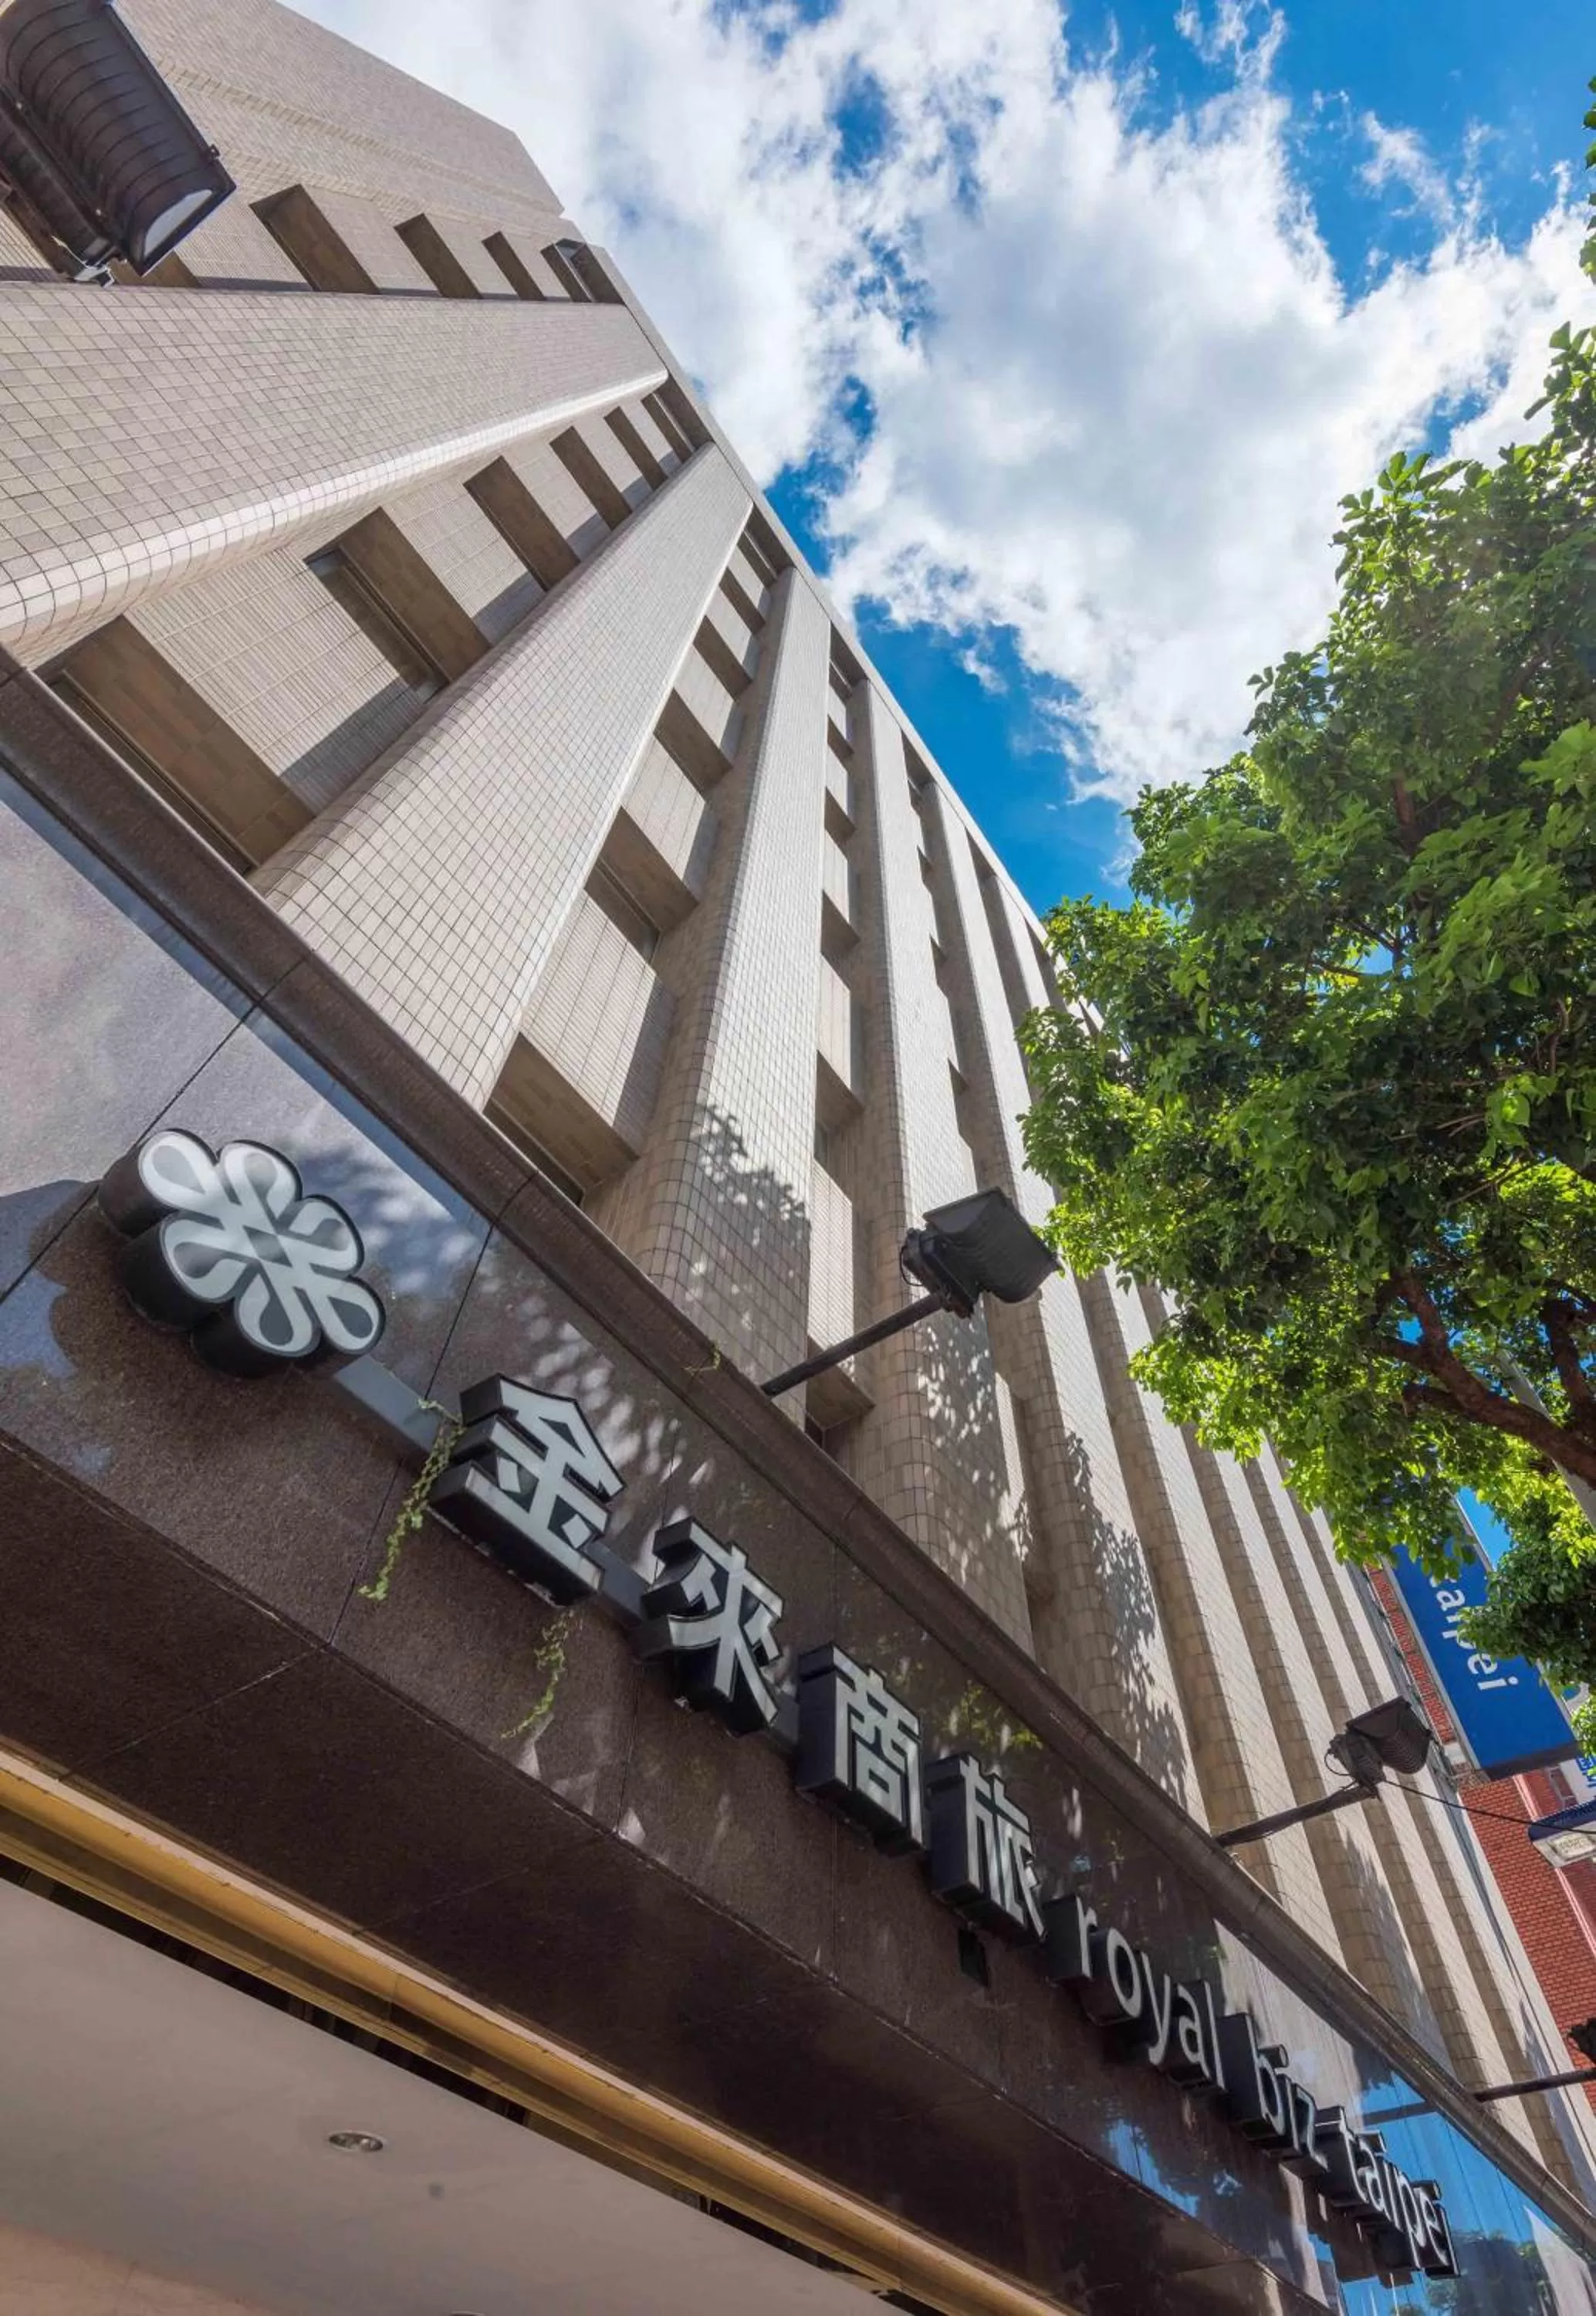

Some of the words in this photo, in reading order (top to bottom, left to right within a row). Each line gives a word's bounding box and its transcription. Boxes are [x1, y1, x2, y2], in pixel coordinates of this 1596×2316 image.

[464, 1373, 1048, 1941] 金來商旅
[1076, 1895, 1226, 2091] royal
[1244, 2011, 1329, 2174] biz
[1338, 2104, 1461, 2277] taipei
[1429, 1573, 1519, 1691] apei
